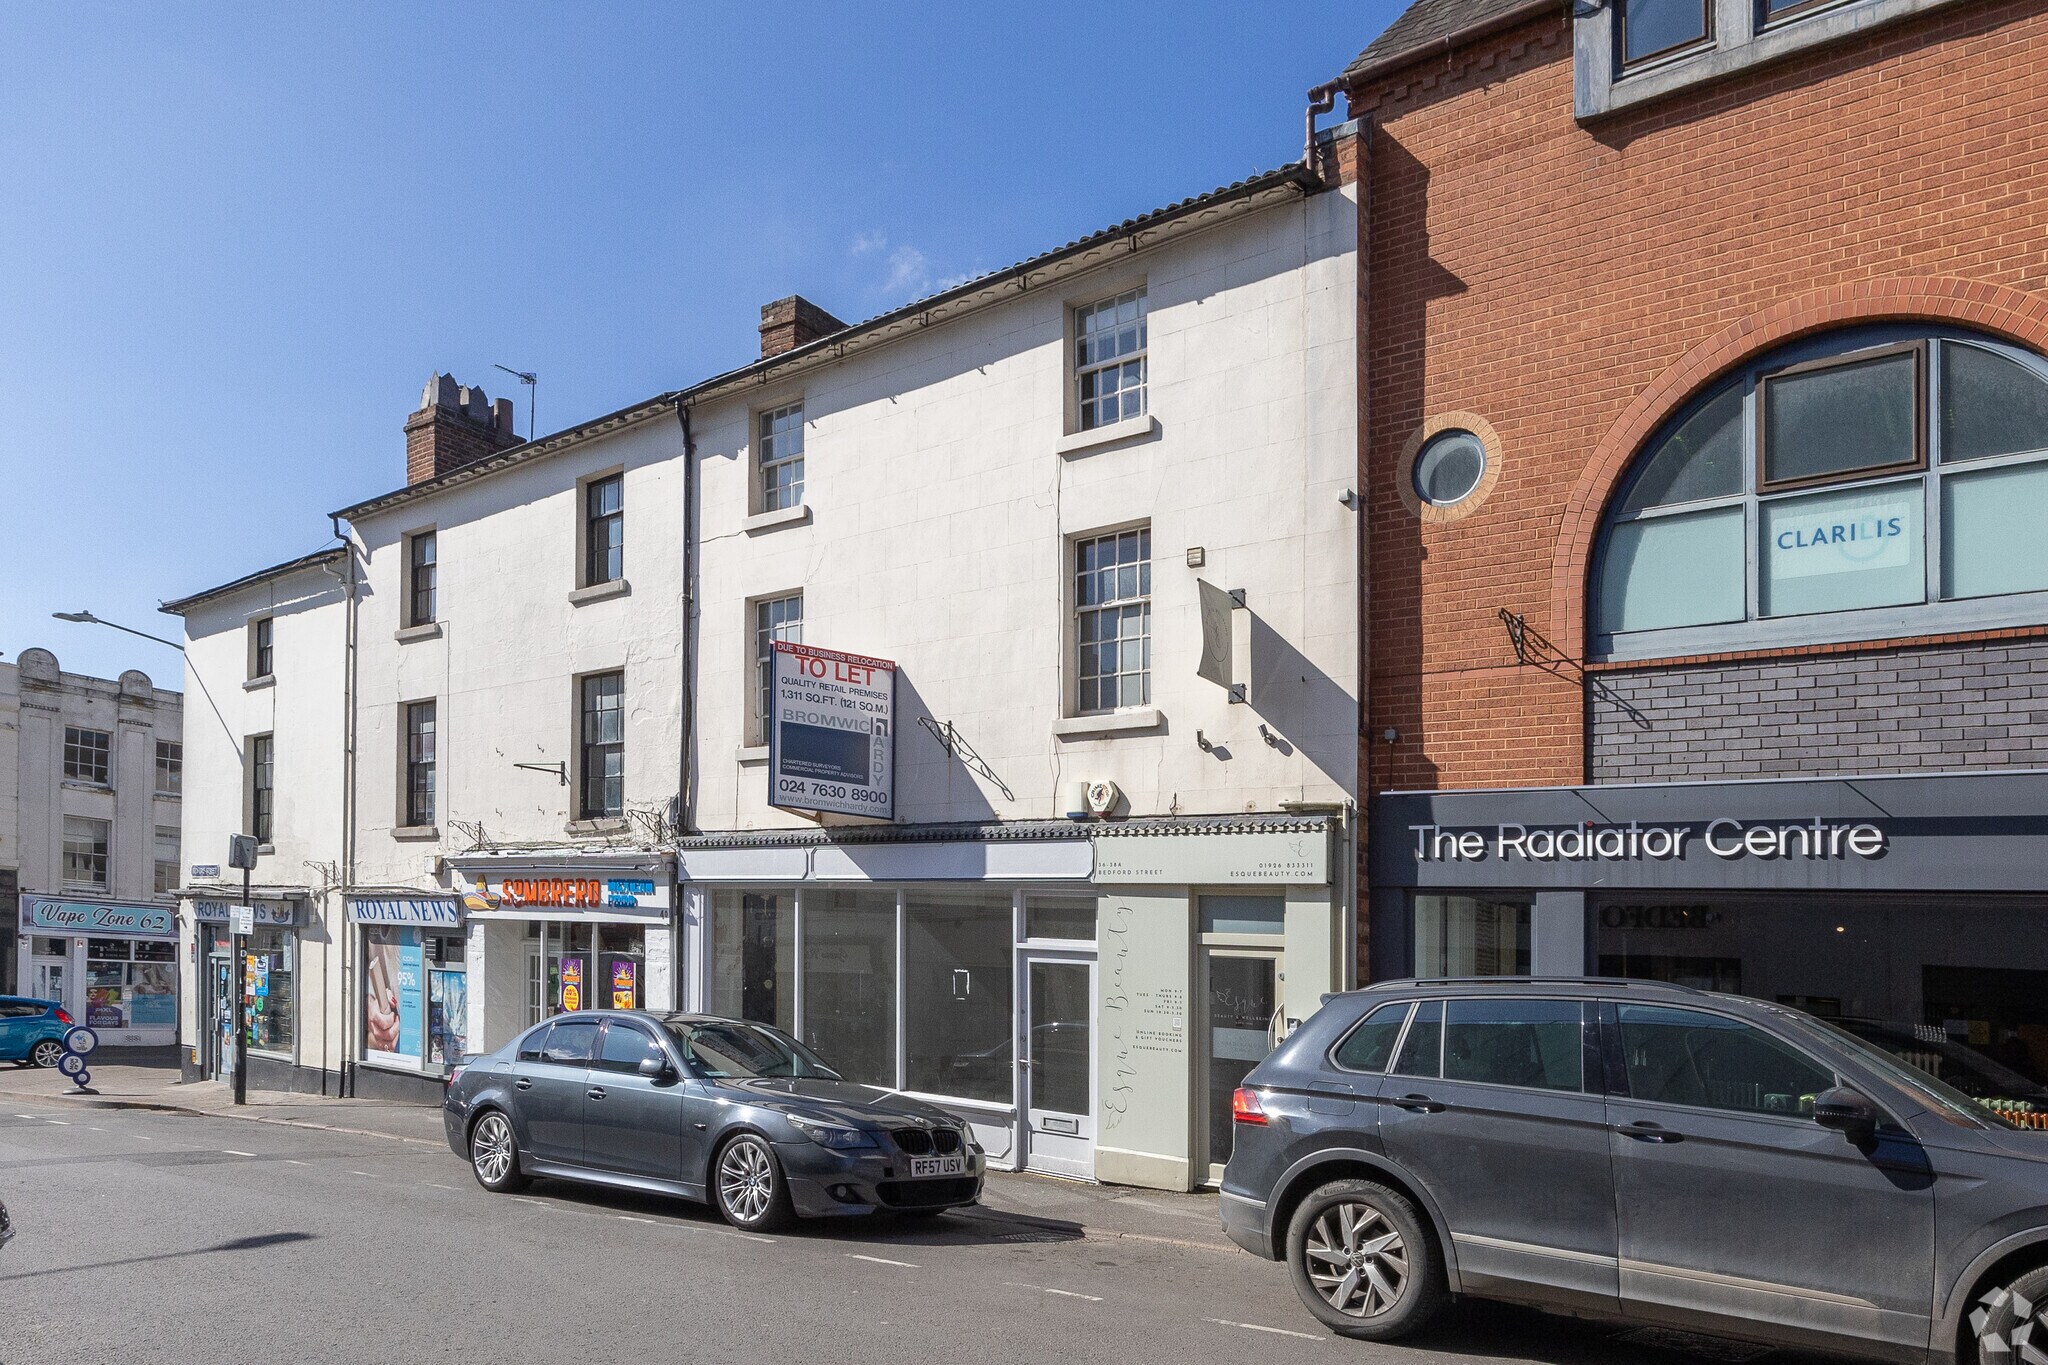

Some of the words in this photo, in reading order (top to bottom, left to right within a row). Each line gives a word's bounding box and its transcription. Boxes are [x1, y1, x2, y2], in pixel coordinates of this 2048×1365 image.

[1777, 517, 1901, 549] CLARILIS
[777, 643, 793, 652] DUE
[796, 645, 806, 654] TO
[809, 647, 846, 661] BUSINESS
[848, 656, 893, 669] RELOCATION
[795, 655, 826, 678] TO
[835, 663, 875, 686] LET
[781, 677, 817, 688] QUALITY
[820, 683, 846, 693] RETAIL
[849, 688, 888, 700] PREMISES
[806, 692, 837, 706] SQ.FT.
[840, 697, 856, 709] (121
[859, 701, 888, 715] SQ.M.)
[782, 764, 814, 773] COMMERCIAL
[815, 768, 840, 776] PROPERTY
[783, 759, 812, 767] CHARTERED
[813, 762, 841, 771] SURVEYORS
[780, 779, 806, 793] 024
[811, 783, 846, 798] 7630
[851, 789, 887, 804] 8900
[779, 794, 887, 814] www.bromwichhardy.com
[1408, 825, 1483, 859] The
[1498, 820, 1690, 858] Radiator
[1705, 816, 1883, 856] Centre
[502, 878, 601, 908] SOMBRERO
[41, 903, 86, 926] Vape
[93, 907, 134, 927] Zone
[140, 912, 164, 929] 62
[198, 902, 230, 918] ROYAL
[355, 899, 407, 920] ROYAL
[410, 900, 457, 922] NEWS
[1105, 897, 1134, 1010] Beauty
[397, 972, 415, 986] 95%
[1104, 1025, 1137, 1113] Esque
[915, 1160, 940, 1174] RF57
[944, 1159, 961, 1172] USV
